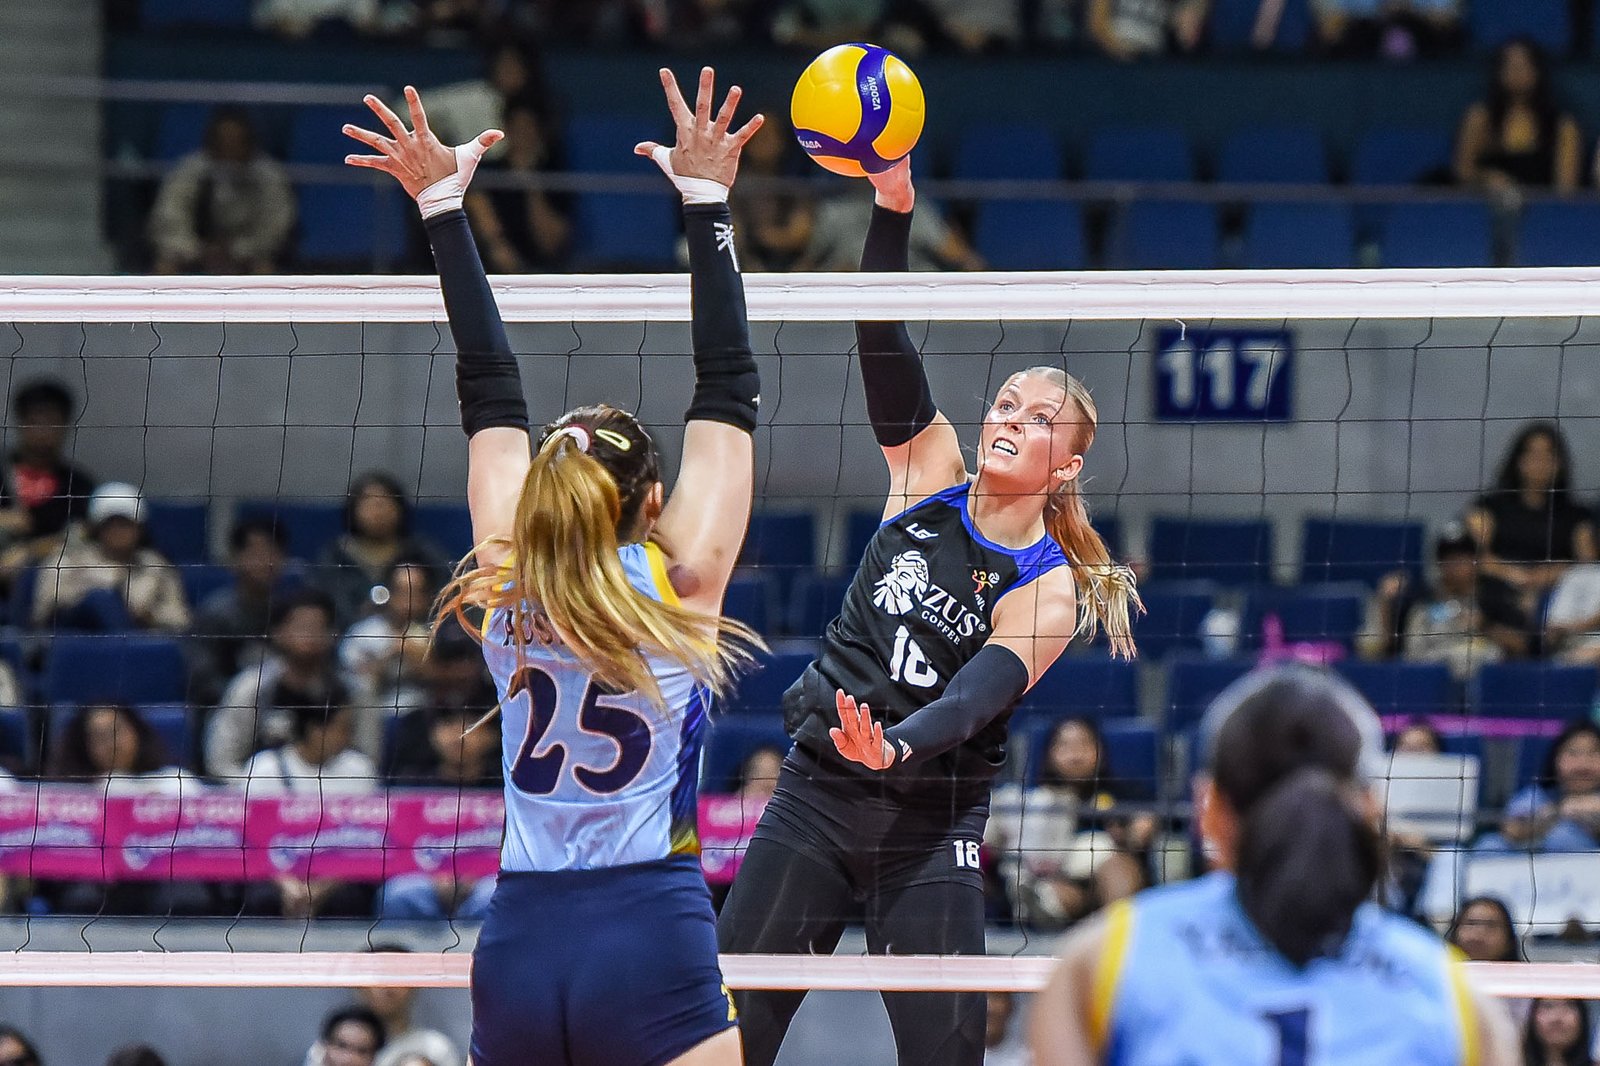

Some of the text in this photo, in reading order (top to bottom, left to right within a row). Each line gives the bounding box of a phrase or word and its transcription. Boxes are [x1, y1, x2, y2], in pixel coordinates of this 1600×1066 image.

[866, 75, 882, 111] V200W
[1157, 337, 1288, 410] 117
[921, 610, 961, 646] COFFEE
[506, 664, 656, 796] 25
[953, 839, 980, 869] 18
